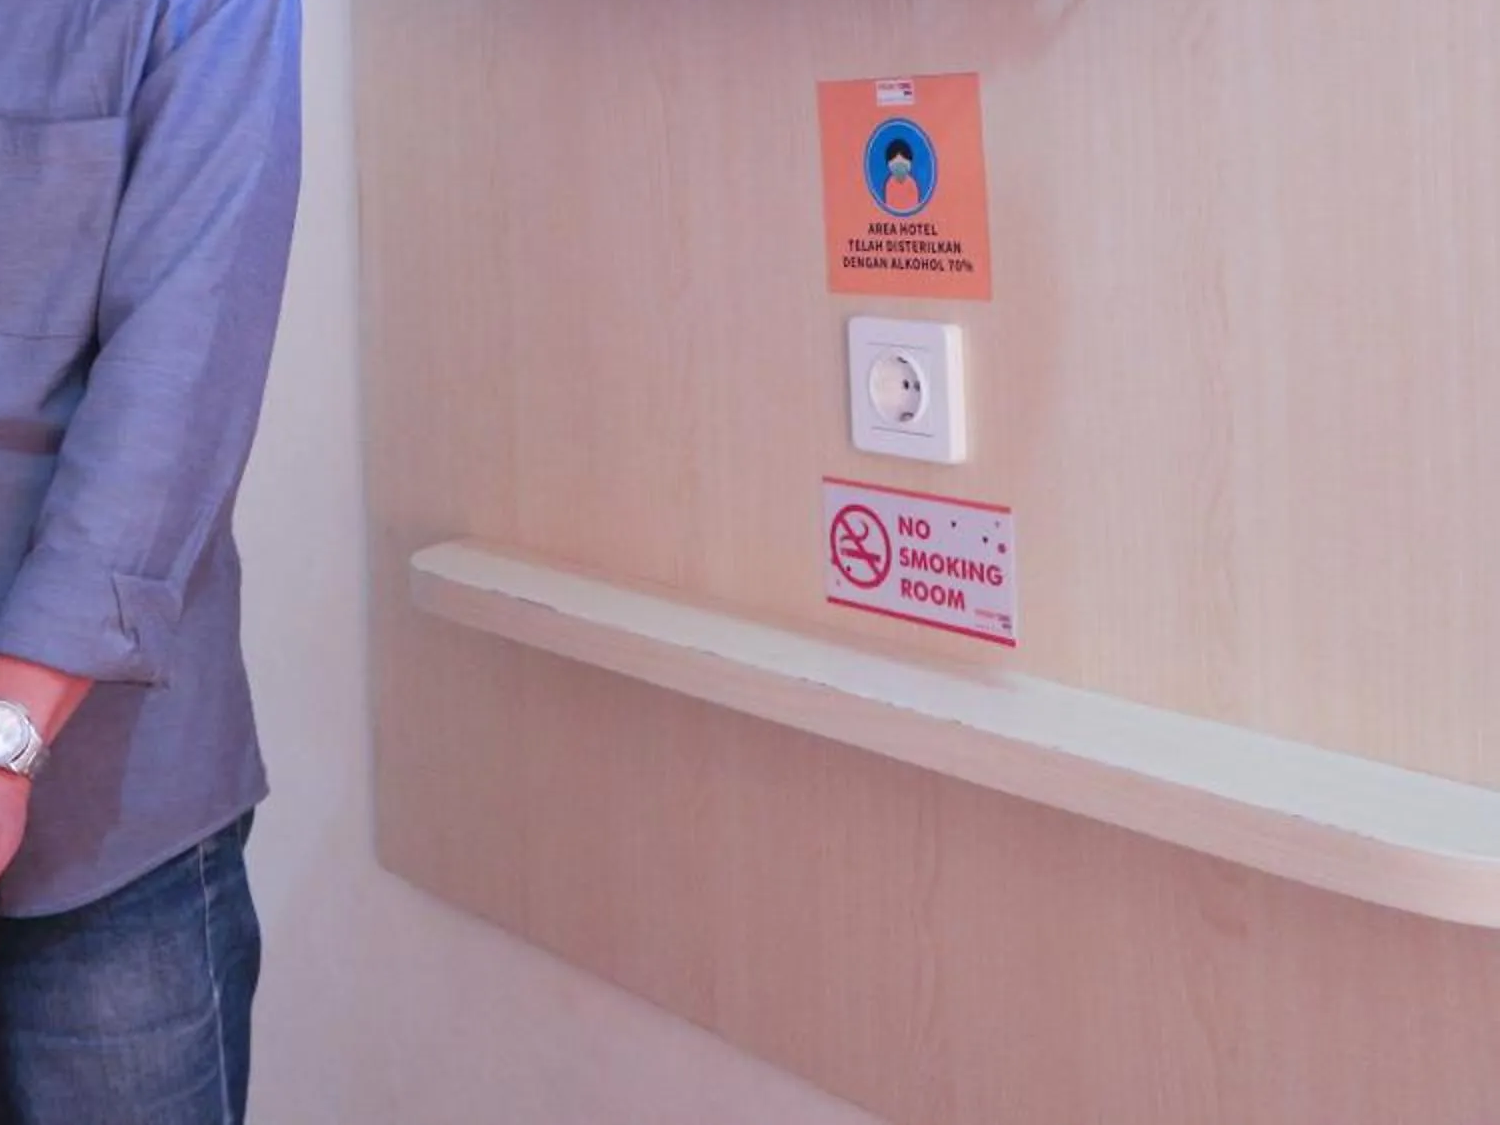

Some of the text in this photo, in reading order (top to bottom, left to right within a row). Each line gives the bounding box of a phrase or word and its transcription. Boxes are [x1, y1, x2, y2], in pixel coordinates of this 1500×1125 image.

[867, 222, 939, 237] AREA HOTEL
[847, 238, 962, 255] TELAH DISTERILKAN
[842, 256, 975, 273] DENGAN ALKOHOL 70%
[897, 514, 931, 541] NO
[899, 546, 1003, 587] SMOKING
[900, 577, 966, 612] ROOM
